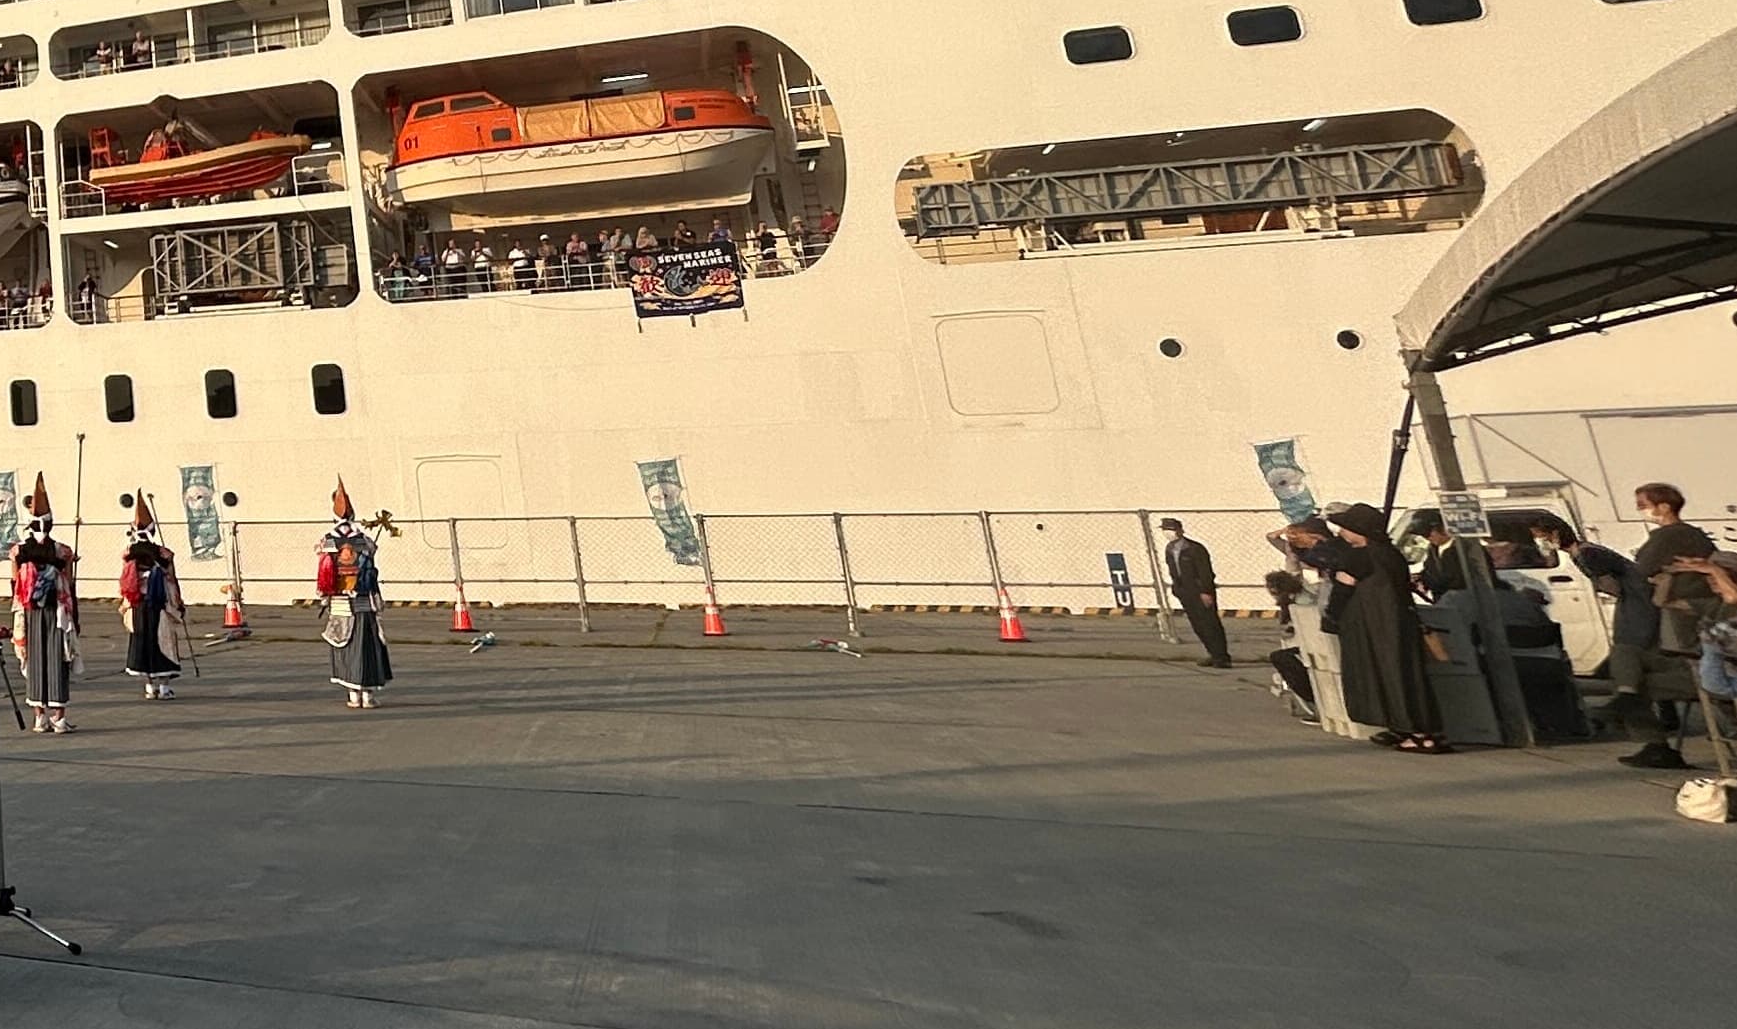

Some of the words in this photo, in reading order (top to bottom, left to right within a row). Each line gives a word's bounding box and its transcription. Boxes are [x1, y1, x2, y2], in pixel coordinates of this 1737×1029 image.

[404, 136, 418, 150] 01
[657, 252, 692, 264] SEVEN
[694, 248, 722, 260] SEAS
[683, 255, 732, 269] MARINER
